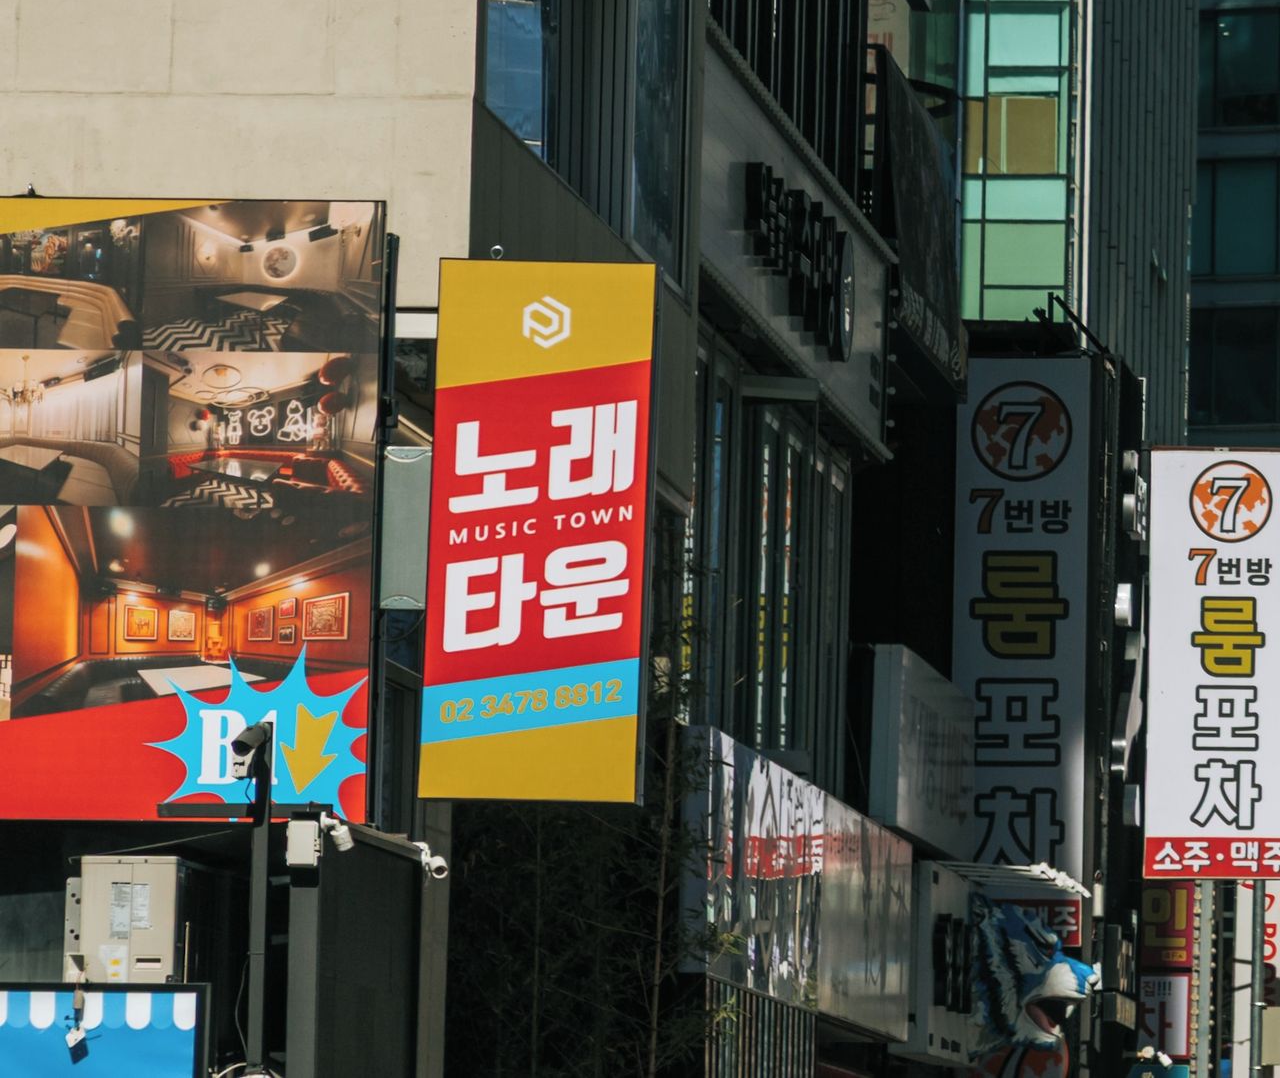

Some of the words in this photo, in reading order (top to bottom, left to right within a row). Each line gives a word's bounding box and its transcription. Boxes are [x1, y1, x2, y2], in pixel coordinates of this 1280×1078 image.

[448, 400, 636, 513] 노래
[449, 517, 538, 545] MUSIC
[554, 505, 634, 532] TOWN
[969, 489, 1072, 535] 7번방
[1210, 477, 1250, 534] 7
[1189, 548, 1272, 587] 7번방
[443, 541, 629, 653] 타운
[440, 698, 475, 724] 02
[480, 687, 549, 719] 3478
[553, 679, 623, 710] 8812
[970, 551, 1070, 865] 룸포차
[1192, 596, 1266, 831] 룸포차
